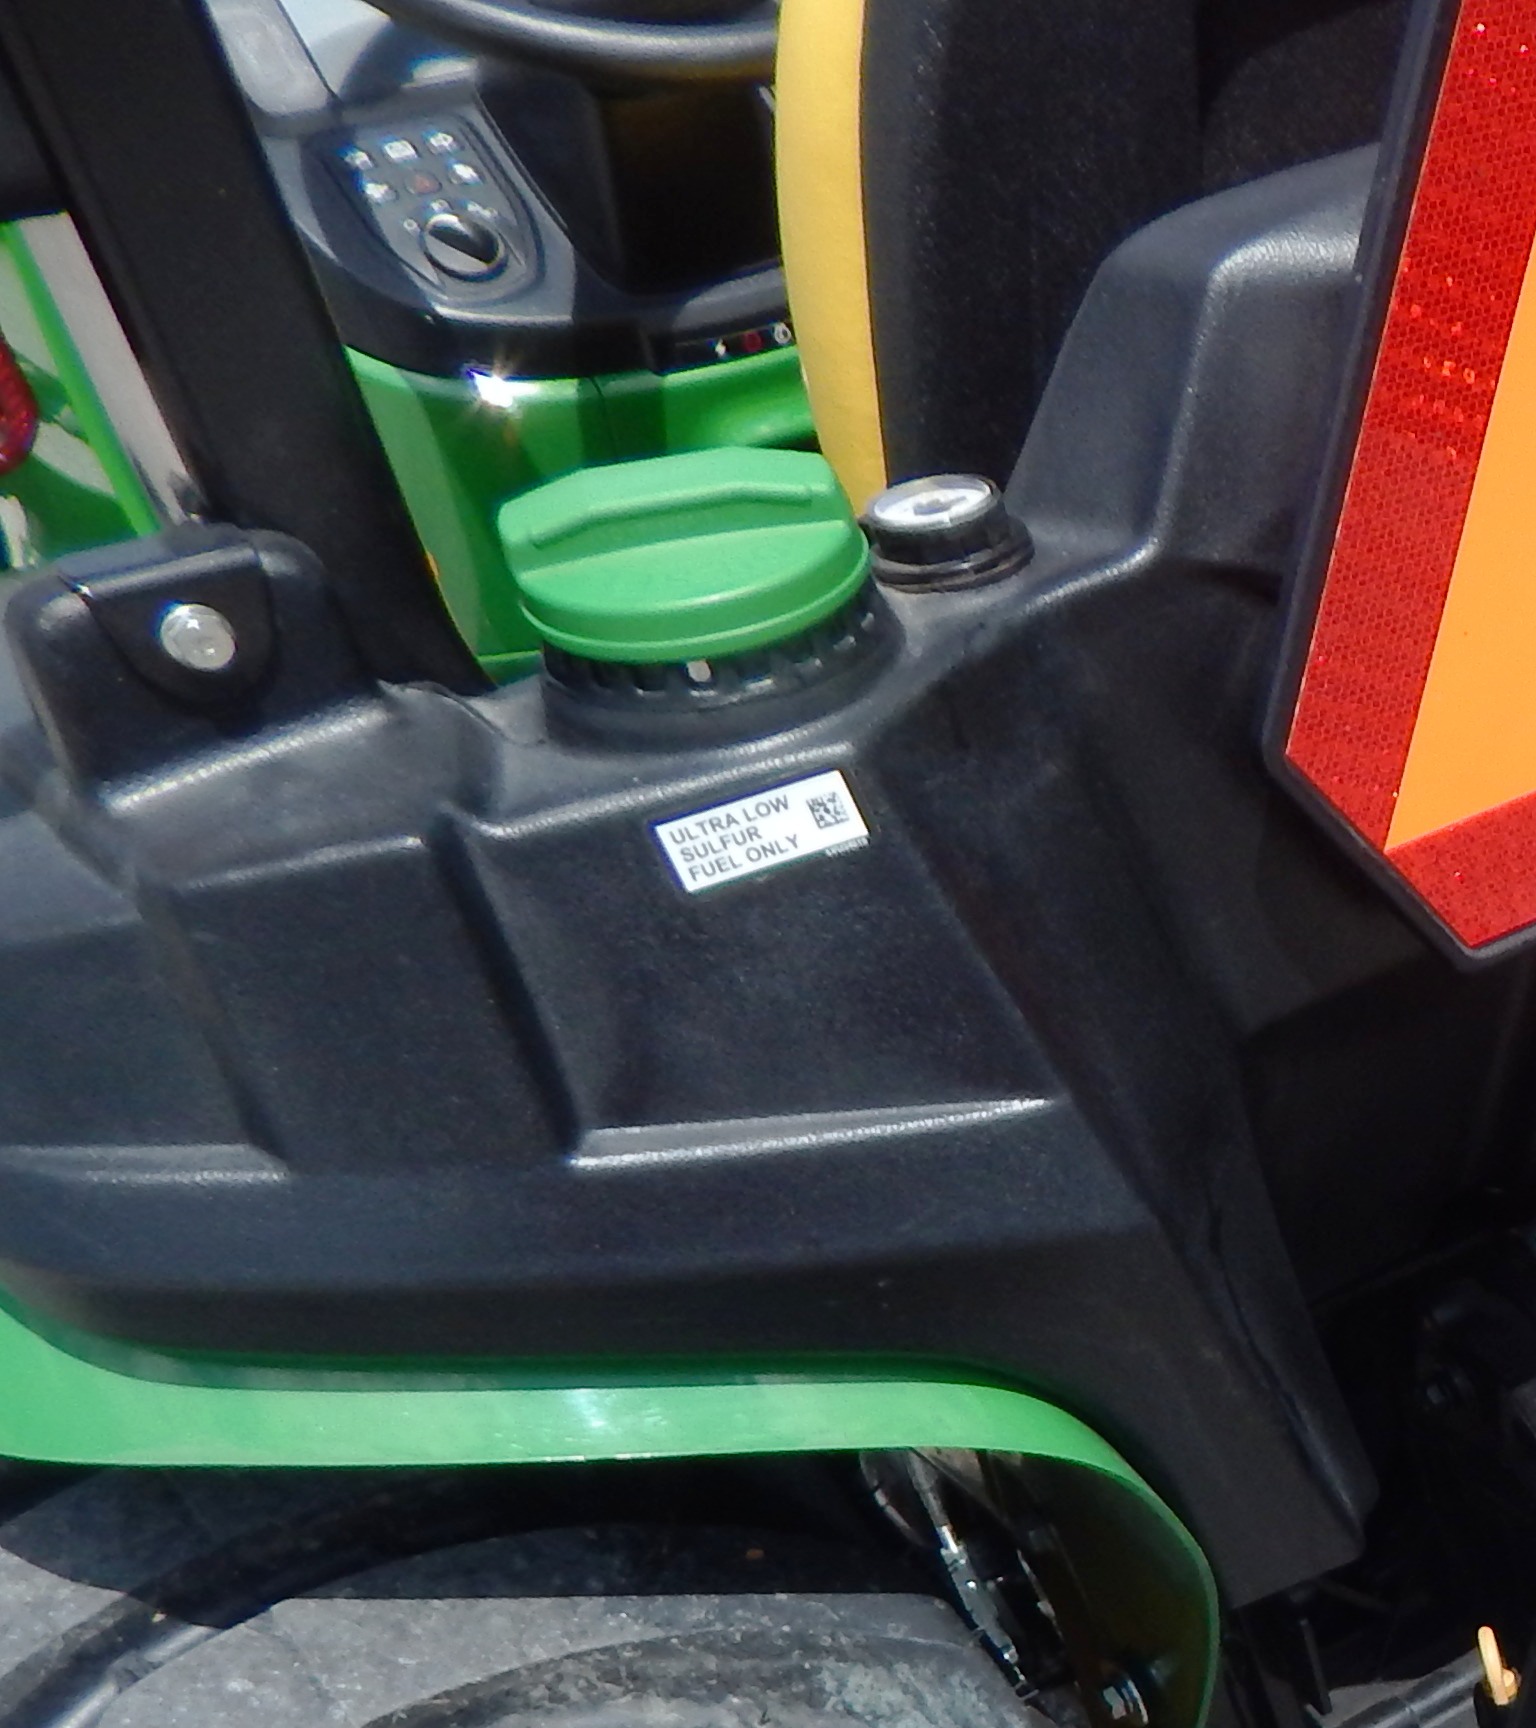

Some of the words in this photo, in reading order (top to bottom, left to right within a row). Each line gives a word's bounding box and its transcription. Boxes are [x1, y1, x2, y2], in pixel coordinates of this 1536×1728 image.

[670, 812, 740, 845] ULTRA
[742, 795, 790, 821] LOW
[680, 826, 762, 863] SULFUR
[688, 857, 743, 881] FUEL
[746, 834, 800, 863] ONLY
